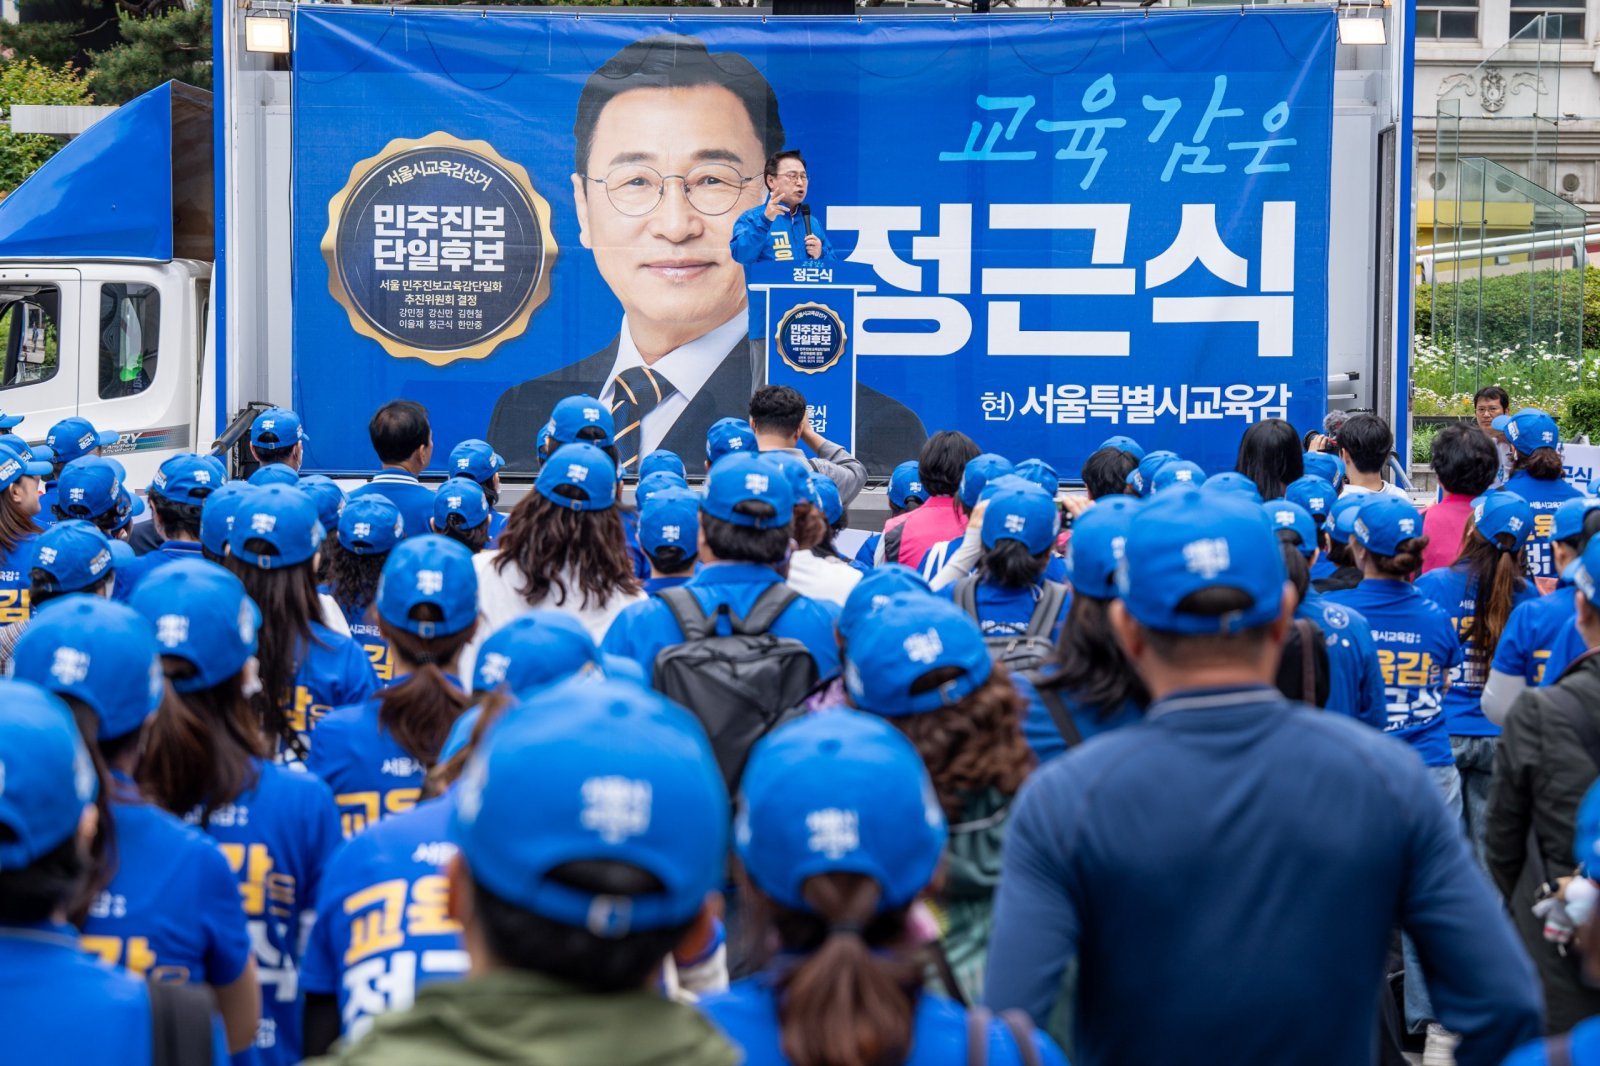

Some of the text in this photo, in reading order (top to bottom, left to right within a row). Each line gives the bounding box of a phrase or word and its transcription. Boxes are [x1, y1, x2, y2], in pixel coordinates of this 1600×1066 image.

[939, 73, 1298, 190] 교육감은
[387, 160, 493, 191] 서울시교육감선거
[373, 204, 506, 238] 민주진보
[373, 239, 506, 272] 단일후보
[792, 268, 833, 282] 정근식
[826, 201, 1296, 357] 정근식
[379, 279, 503, 293] 서울 민주진보교육감단일화
[404, 294, 477, 306] 추진위원회 결정
[399, 308, 483, 319] 강민정 강신만 김현철
[428, 319, 453, 330] 정근식
[790, 324, 832, 335] 민주진보
[790, 335, 832, 346] 단일후보
[980, 383, 1293, 424] 현) 서울특별시교육감
[805, 404, 827, 418] 울시
[1562, 465, 1593, 487] 근식
